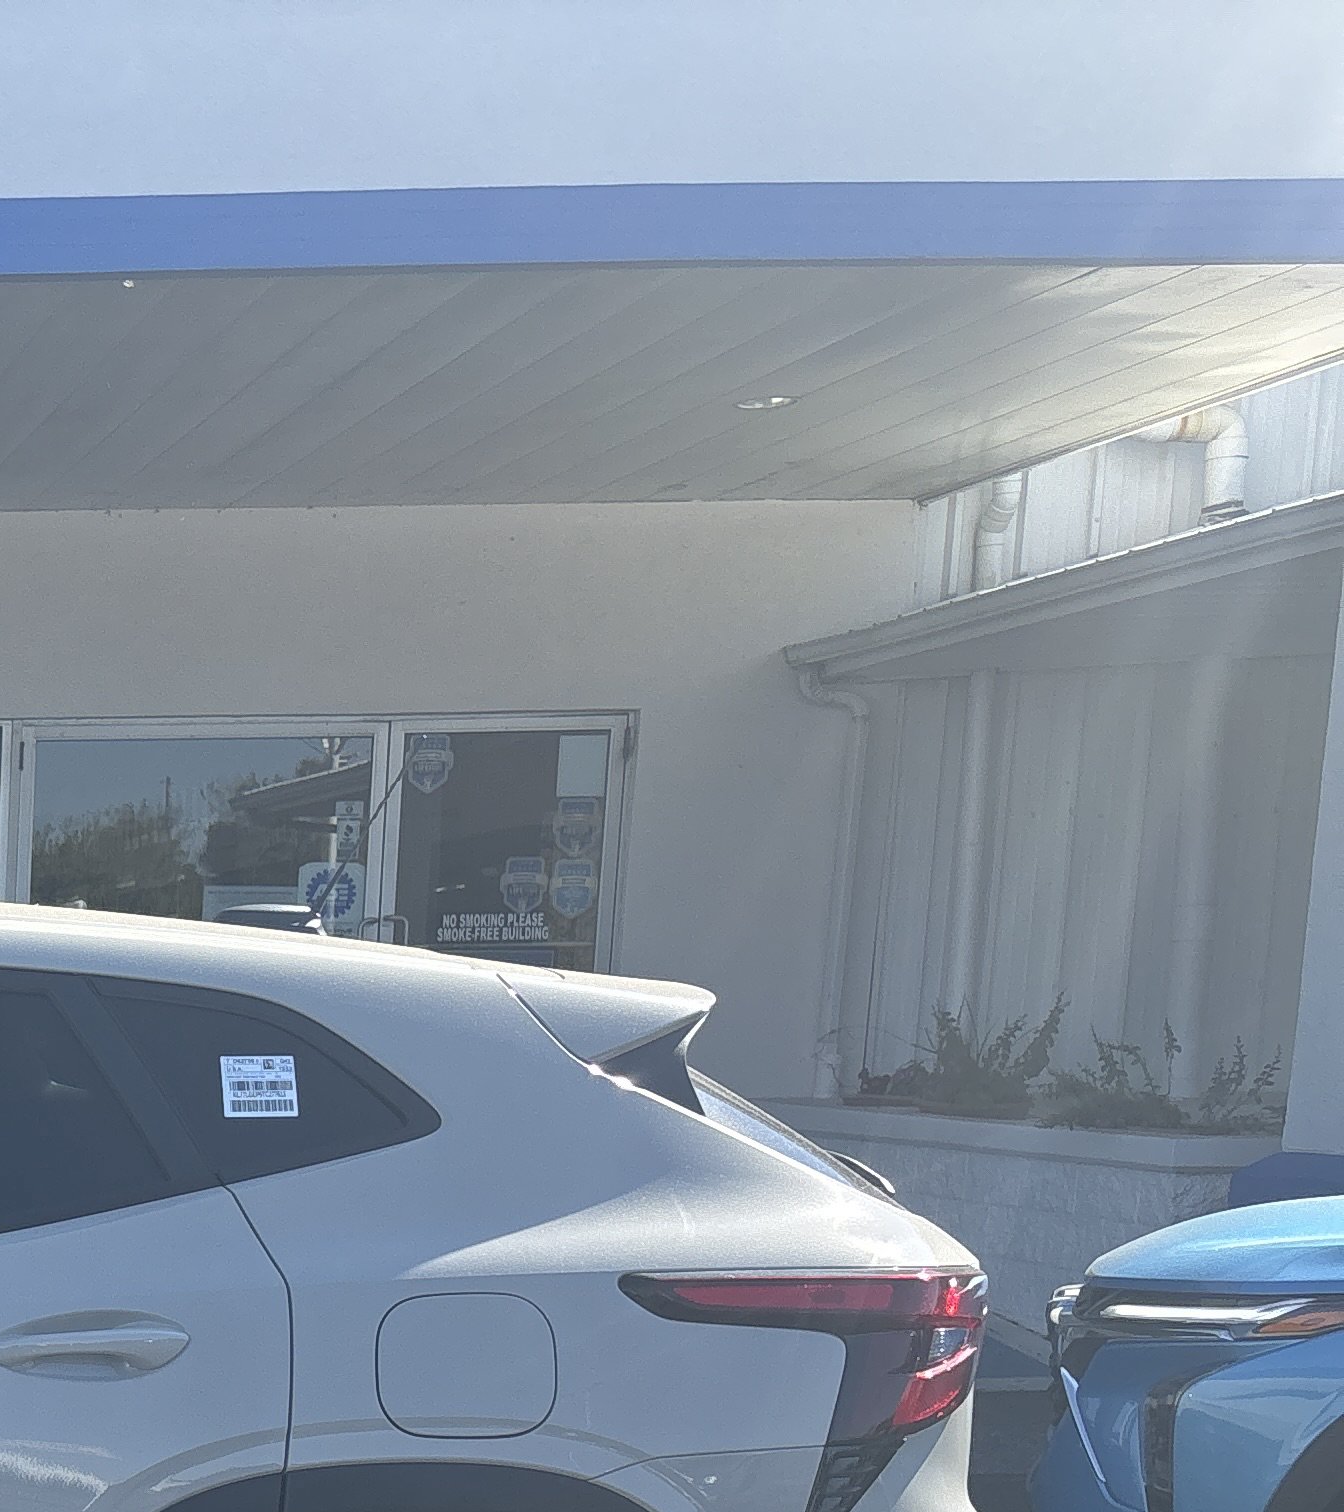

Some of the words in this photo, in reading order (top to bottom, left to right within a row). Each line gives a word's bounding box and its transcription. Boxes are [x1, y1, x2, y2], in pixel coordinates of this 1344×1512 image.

[442, 914, 457, 928] NO
[459, 912, 505, 927] SMOKING
[507, 912, 545, 926] PLEASE
[437, 927, 500, 941] SMOKE-FREE
[502, 926, 549, 940] BUILDING
